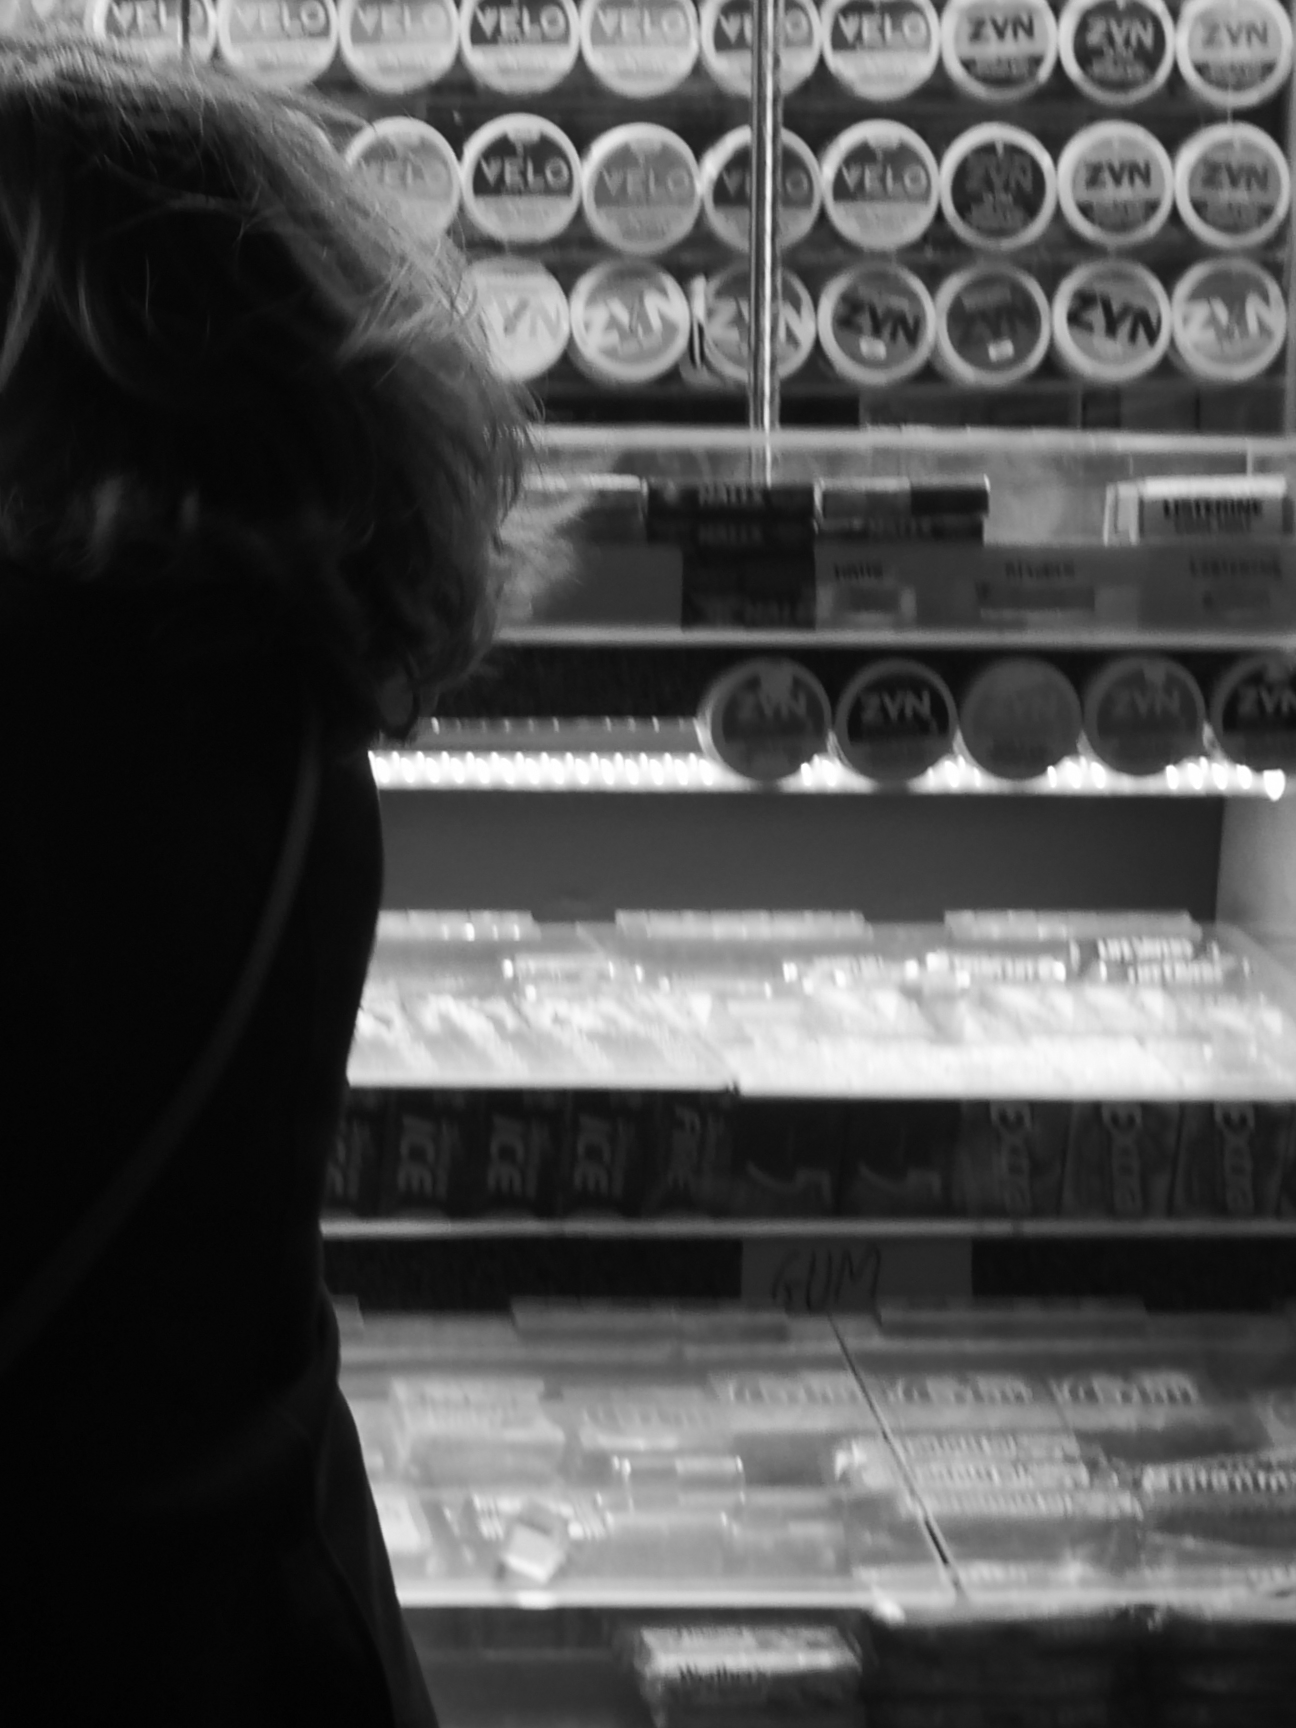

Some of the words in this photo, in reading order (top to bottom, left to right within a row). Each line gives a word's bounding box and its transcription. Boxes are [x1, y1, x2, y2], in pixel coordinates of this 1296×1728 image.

[474, 3, 567, 39] VELO
[838, 12, 927, 49] VELO
[969, 16, 1035, 42] ZYN
[481, 155, 568, 189] VELO
[1085, 163, 1152, 190] ZYN
[1067, 290, 1157, 345] ZYN
[864, 693, 932, 721] ZYN
[770, 1240, 882, 1312] GUM
